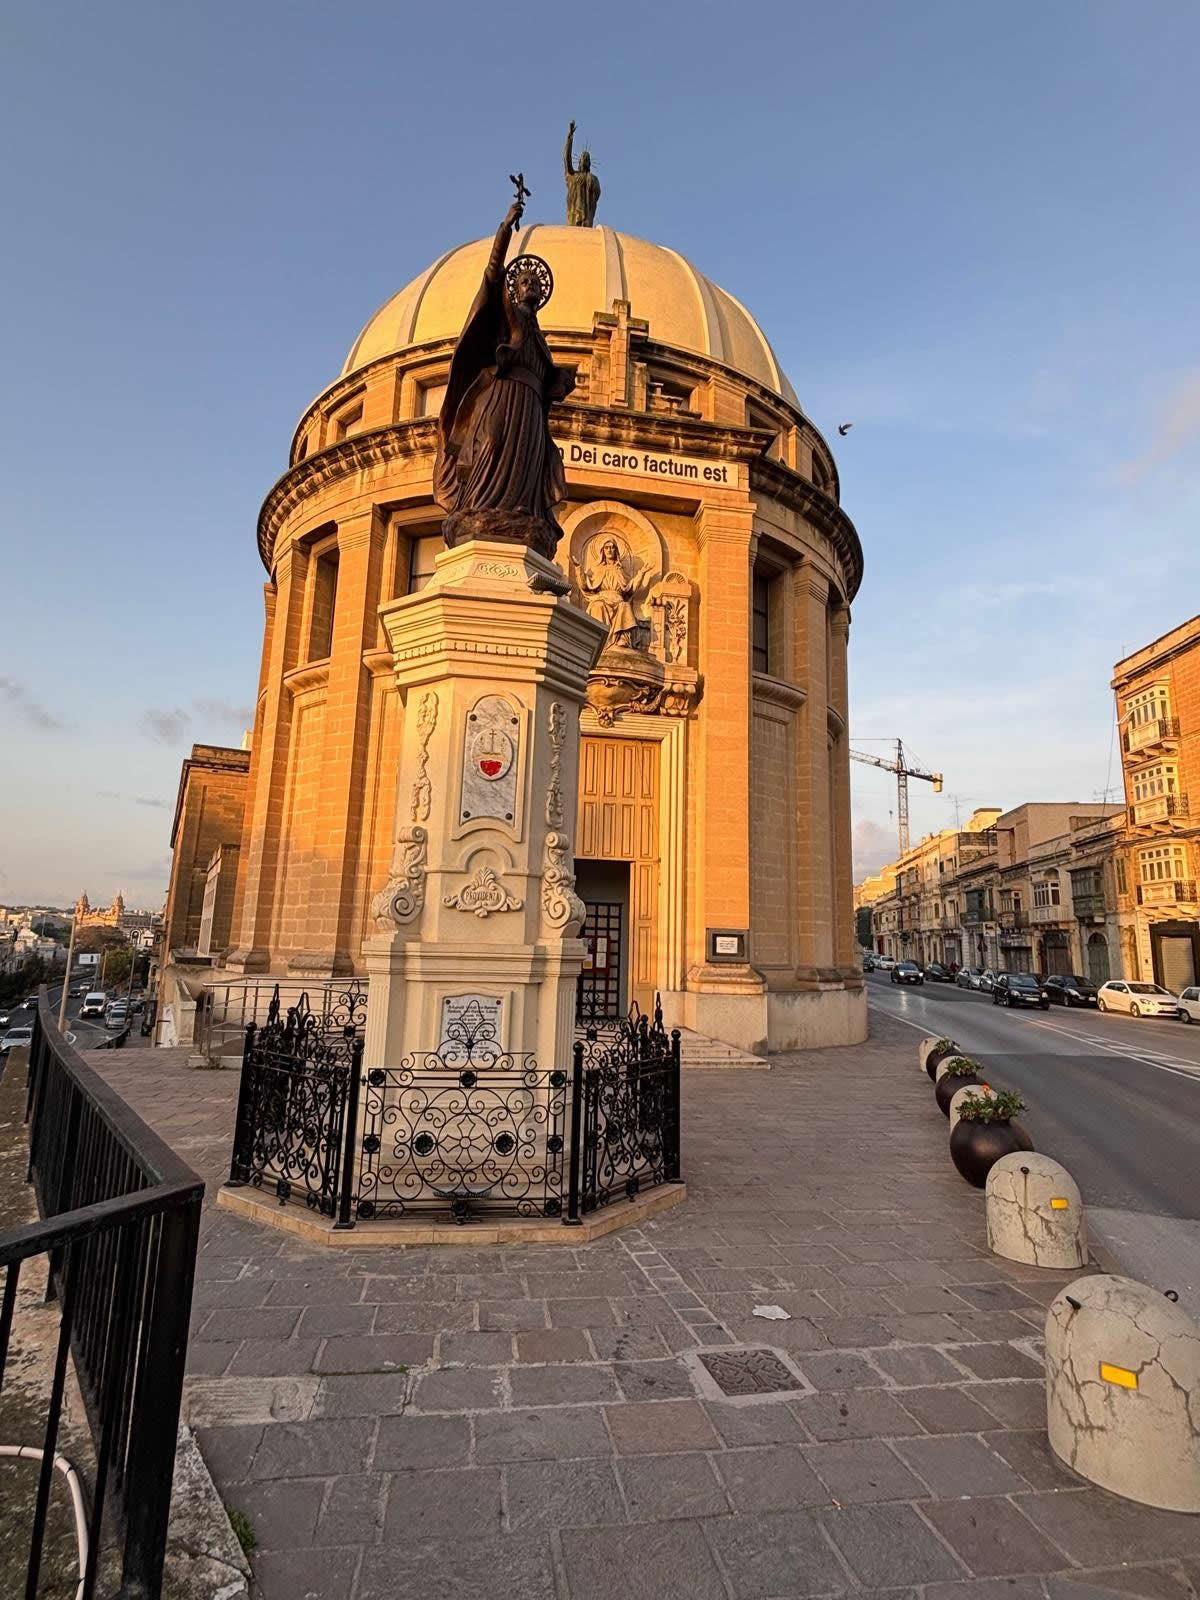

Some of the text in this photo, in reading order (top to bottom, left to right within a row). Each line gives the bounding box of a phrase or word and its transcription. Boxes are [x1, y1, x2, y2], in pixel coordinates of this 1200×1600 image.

[570, 444, 597, 464] Dei
[602, 452, 639, 469] caro
[643, 454, 698, 478] factum
[703, 466, 728, 483] est
